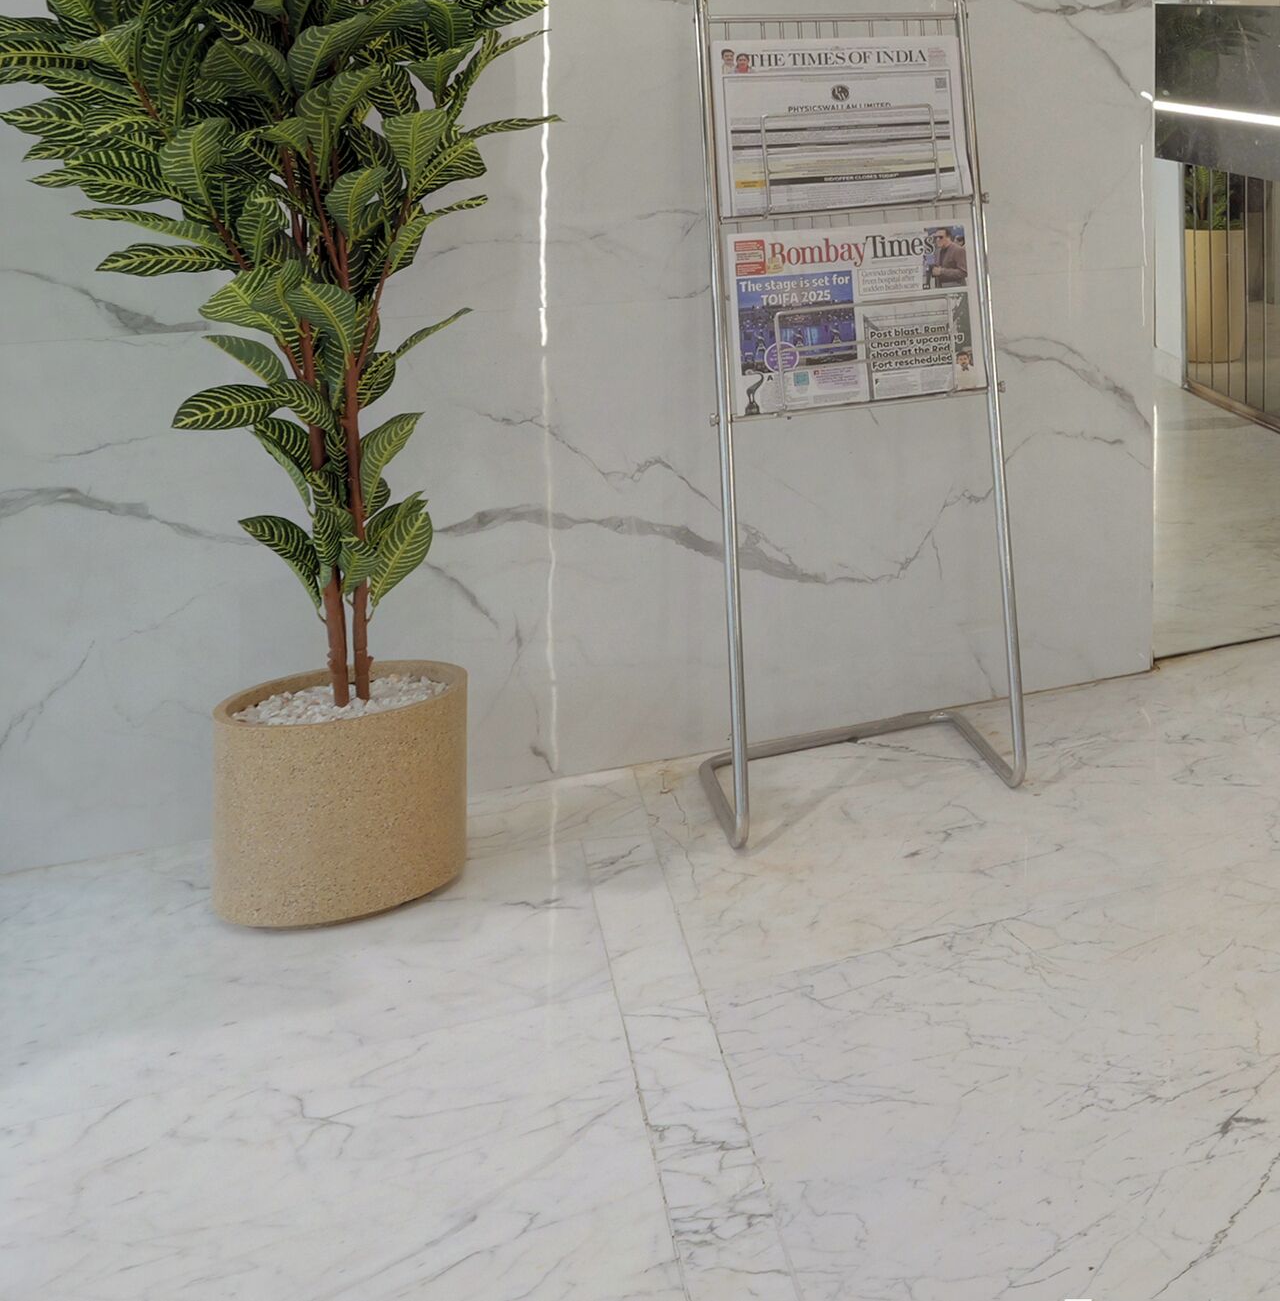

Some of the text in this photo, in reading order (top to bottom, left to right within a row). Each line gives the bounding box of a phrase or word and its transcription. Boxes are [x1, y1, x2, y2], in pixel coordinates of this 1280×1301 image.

[750, 52, 786, 68] THE
[788, 50, 846, 67] TIMES
[848, 49, 873, 65] OF
[876, 48, 928, 64] INDIA
[768, 235, 934, 268] Bombay Times
[739, 274, 850, 292] The stage is set for
[761, 290, 831, 306] TOIFA 2025
[870, 330, 893, 340] Post
[871, 337, 915, 350] Charan's
[871, 349, 899, 360] shoot
[901, 348, 911, 357] at
[914, 346, 930, 355] the
[872, 354, 952, 370] Fort rescheduled
